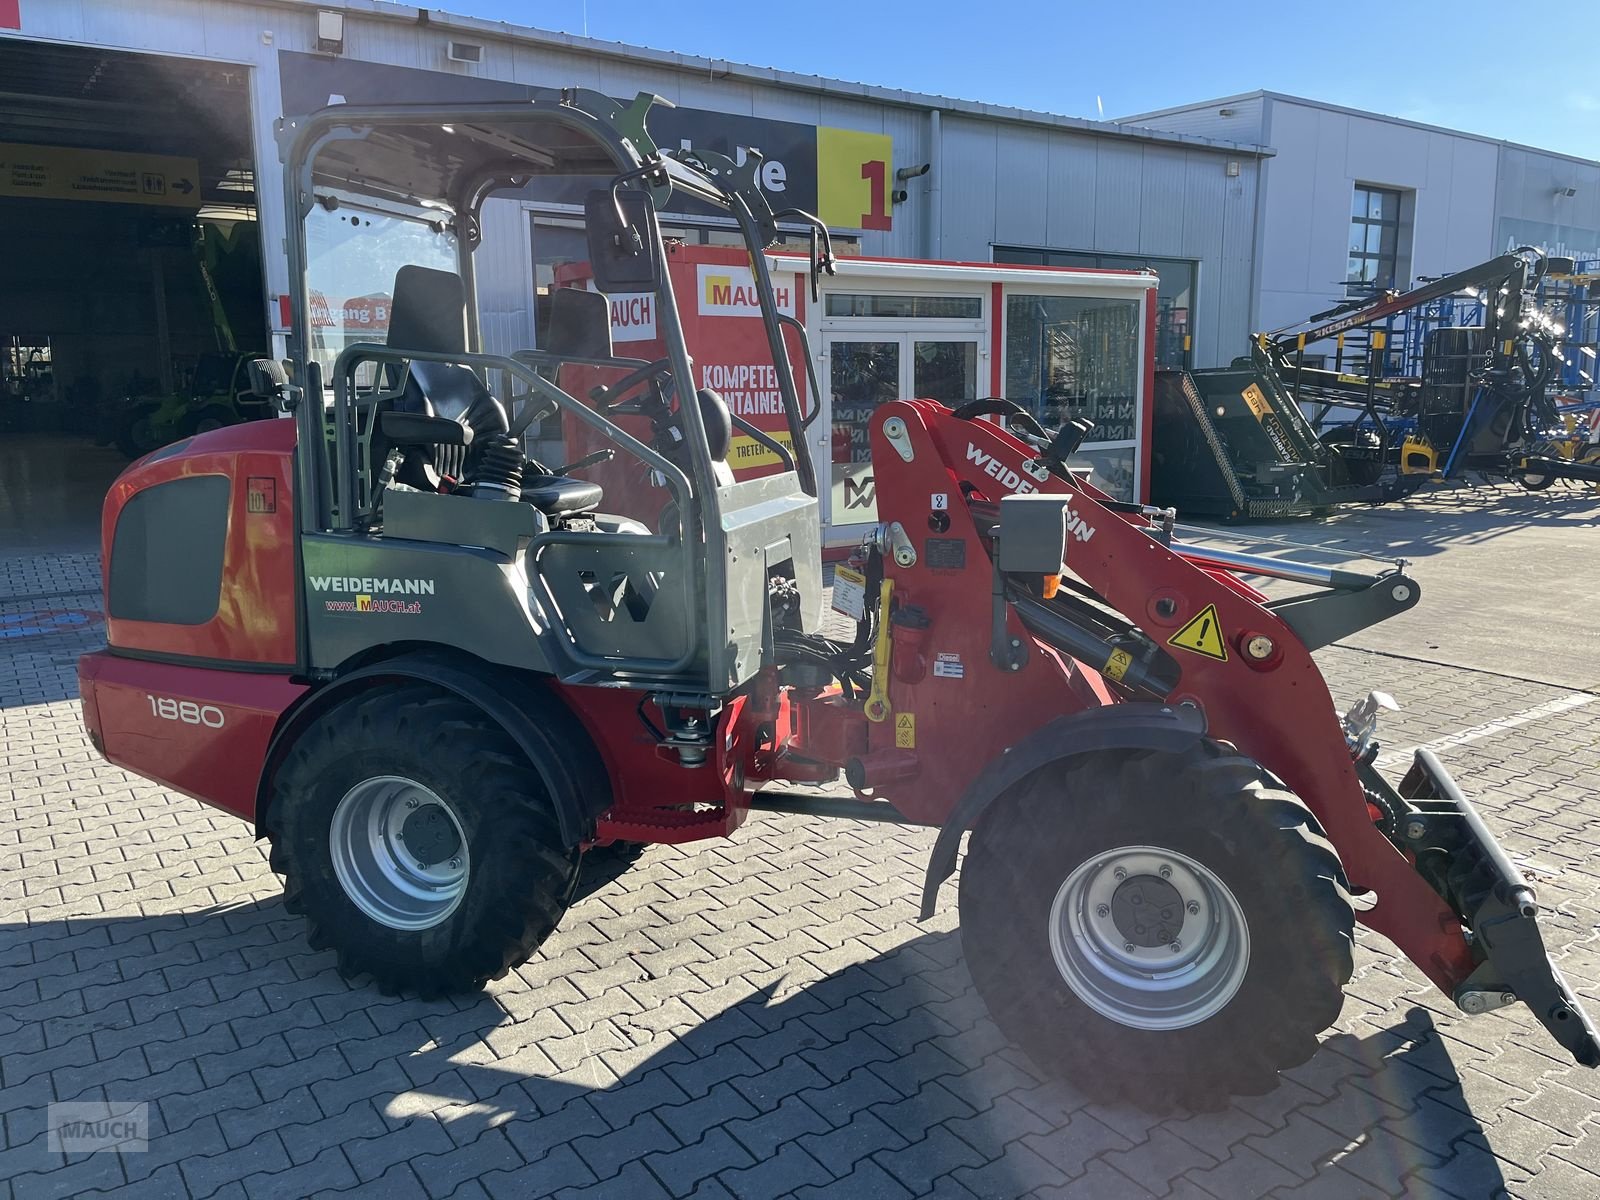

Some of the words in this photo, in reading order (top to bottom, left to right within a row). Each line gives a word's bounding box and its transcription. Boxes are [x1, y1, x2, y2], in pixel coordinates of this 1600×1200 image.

[861, 160, 892, 231] 1
[713, 285, 789, 308] MAUH
[611, 297, 650, 327] AUCH
[702, 365, 793, 389] KOMPETE
[719, 391, 786, 415] NTAINER
[736, 444, 765, 458] TRETEN
[250, 493, 266, 510] 101
[966, 441, 1096, 542] WEIDENN
[309, 576, 435, 595] WEIDEMANN
[325, 600, 421, 614] www.MAUCH.at
[147, 694, 225, 729] 1880
